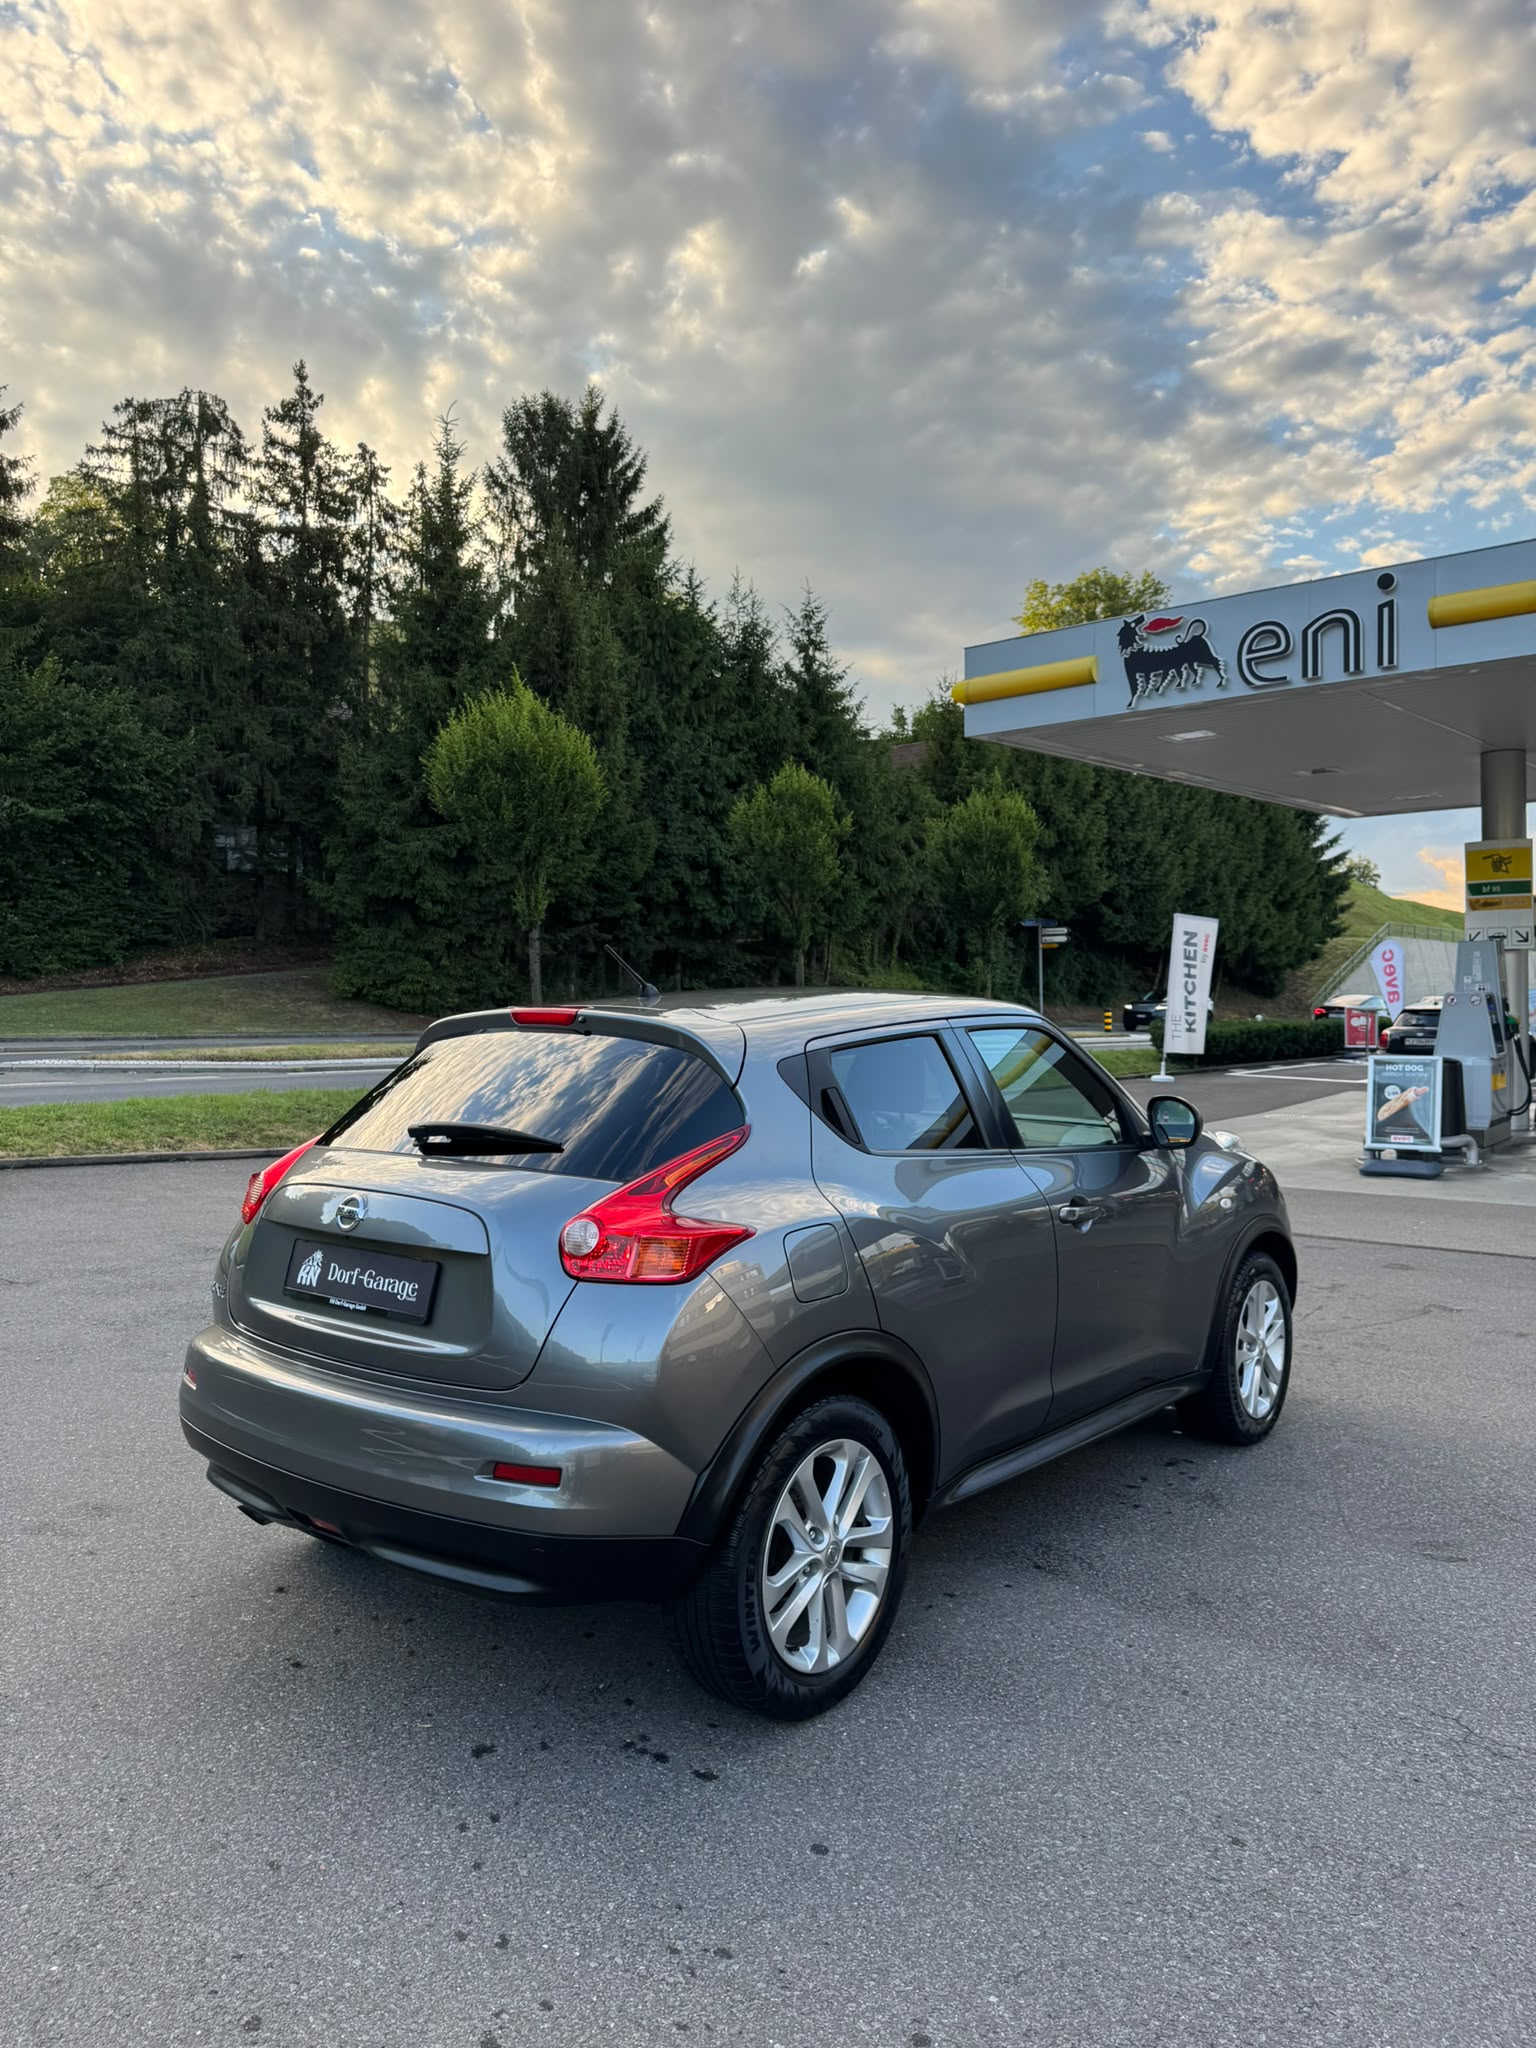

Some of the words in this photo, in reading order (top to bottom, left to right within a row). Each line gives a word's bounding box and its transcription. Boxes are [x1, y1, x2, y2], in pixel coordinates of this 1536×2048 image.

[1237, 572, 1397, 687] eni
[1183, 930, 1198, 1033] KITCHEN
[1170, 1015, 1182, 1040] THE
[1385, 1064, 1404, 1072] HOT
[1405, 1064, 1424, 1072] DOG
[327, 1263, 419, 1301] Dorf-Garage
